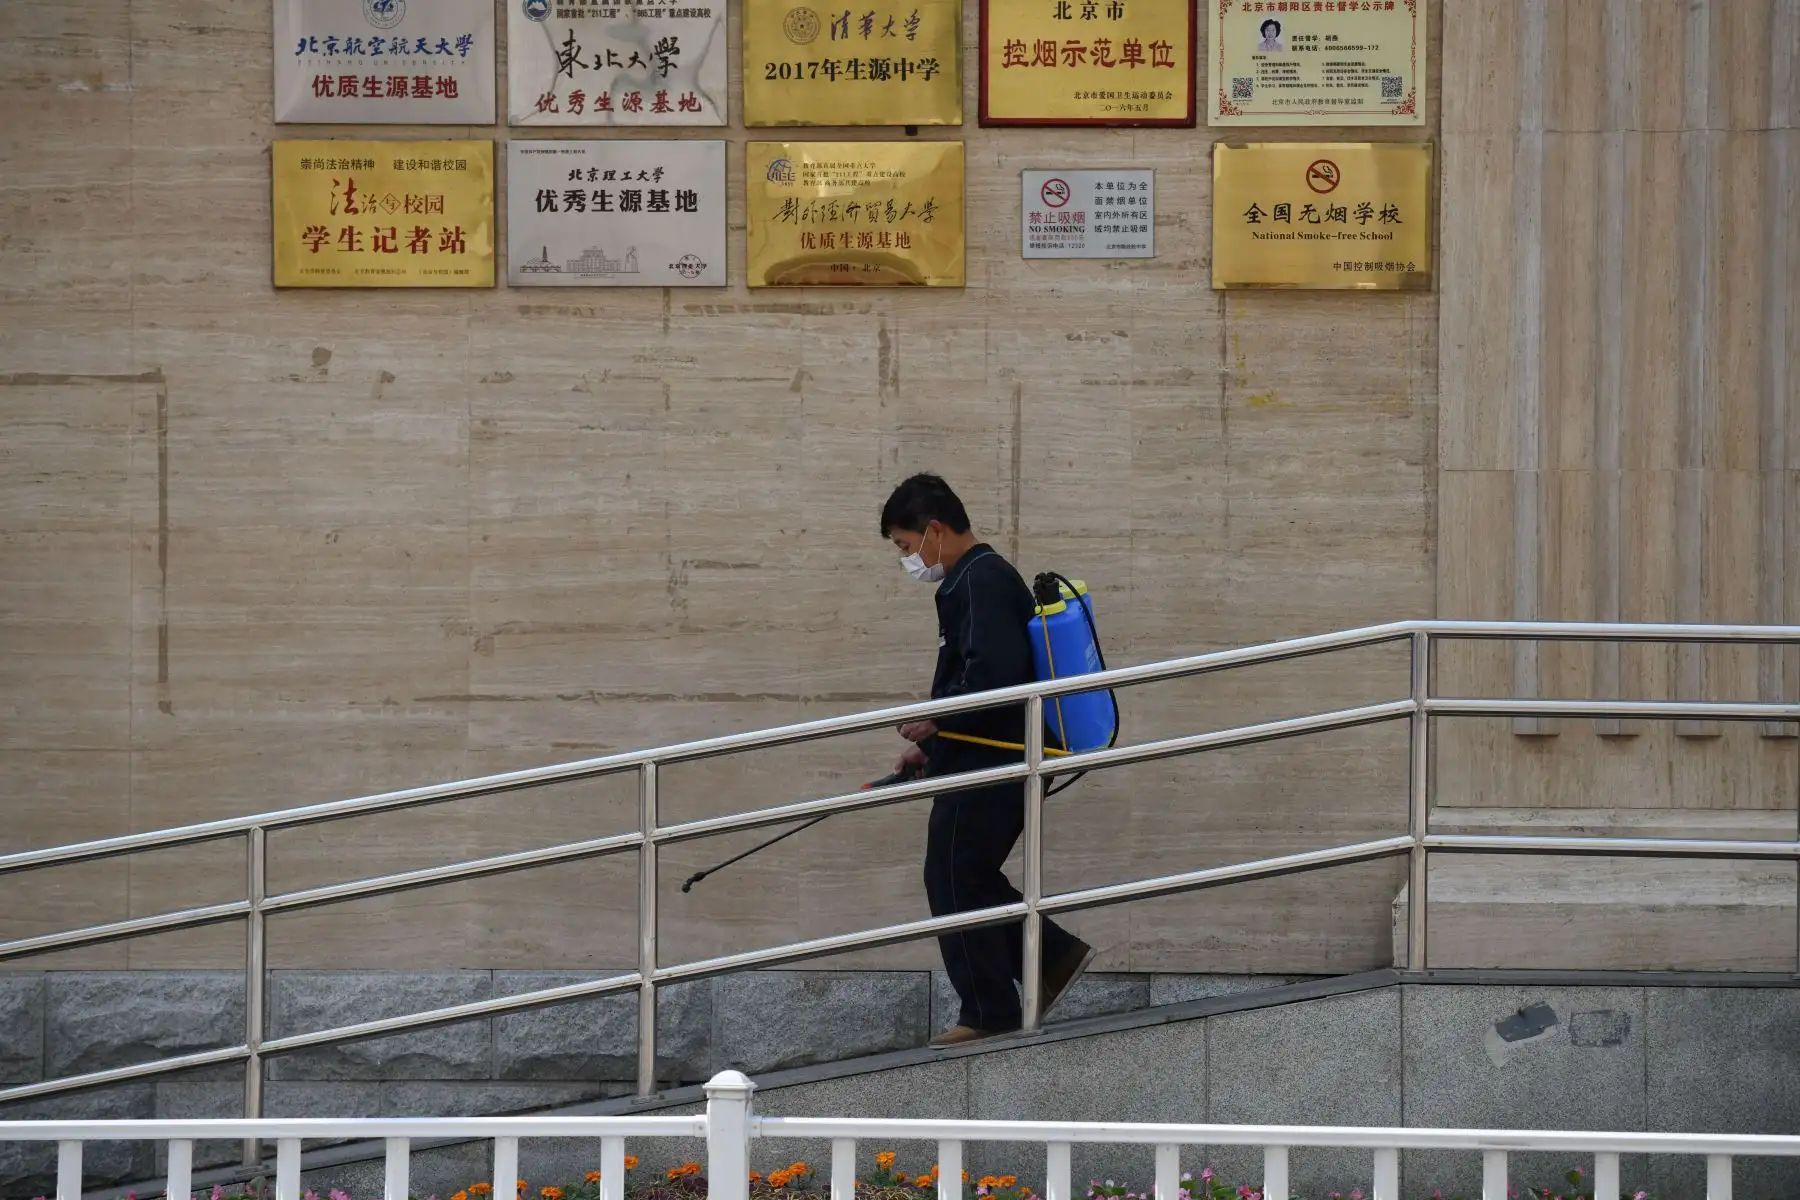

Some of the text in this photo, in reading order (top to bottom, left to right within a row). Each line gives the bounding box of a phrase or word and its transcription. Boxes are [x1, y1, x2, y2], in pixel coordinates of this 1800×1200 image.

[1053, 1, 1125, 21] 北京市
[1242, 1, 1395, 12] 北京市朝阳区责任督学公示牌
[1002, 38, 1175, 68] 控烟示范单位
[765, 58, 940, 82] 2017年生源中学
[312, 75, 459, 98] 优质生源基地
[534, 88, 702, 115] 优秀生源基地
[1073, 91, 1172, 100] 北京市爱国卫生运动委员会
[300, 158, 467, 171] 崇尚法治精神 建设和谐校园
[1095, 181, 1148, 191] 本单位为全
[330, 177, 444, 215] 法治与校园
[535, 189, 698, 213] 优秀生源基地
[1095, 196, 1148, 206] 面禁烟单位
[1029, 211, 1086, 224] 禁止吸烟
[1094, 210, 1148, 220] 室内外所有区
[1243, 202, 1403, 225] 全国无烟学校
[1094, 224, 1148, 233] 域均禁止吸烟
[1252, 231, 1393, 240] National Smoke-free School
[302, 225, 467, 254] 学生记者站
[801, 231, 911, 249] 优质生源基地
[1333, 261, 1416, 272] 中国控制吸烟协会
